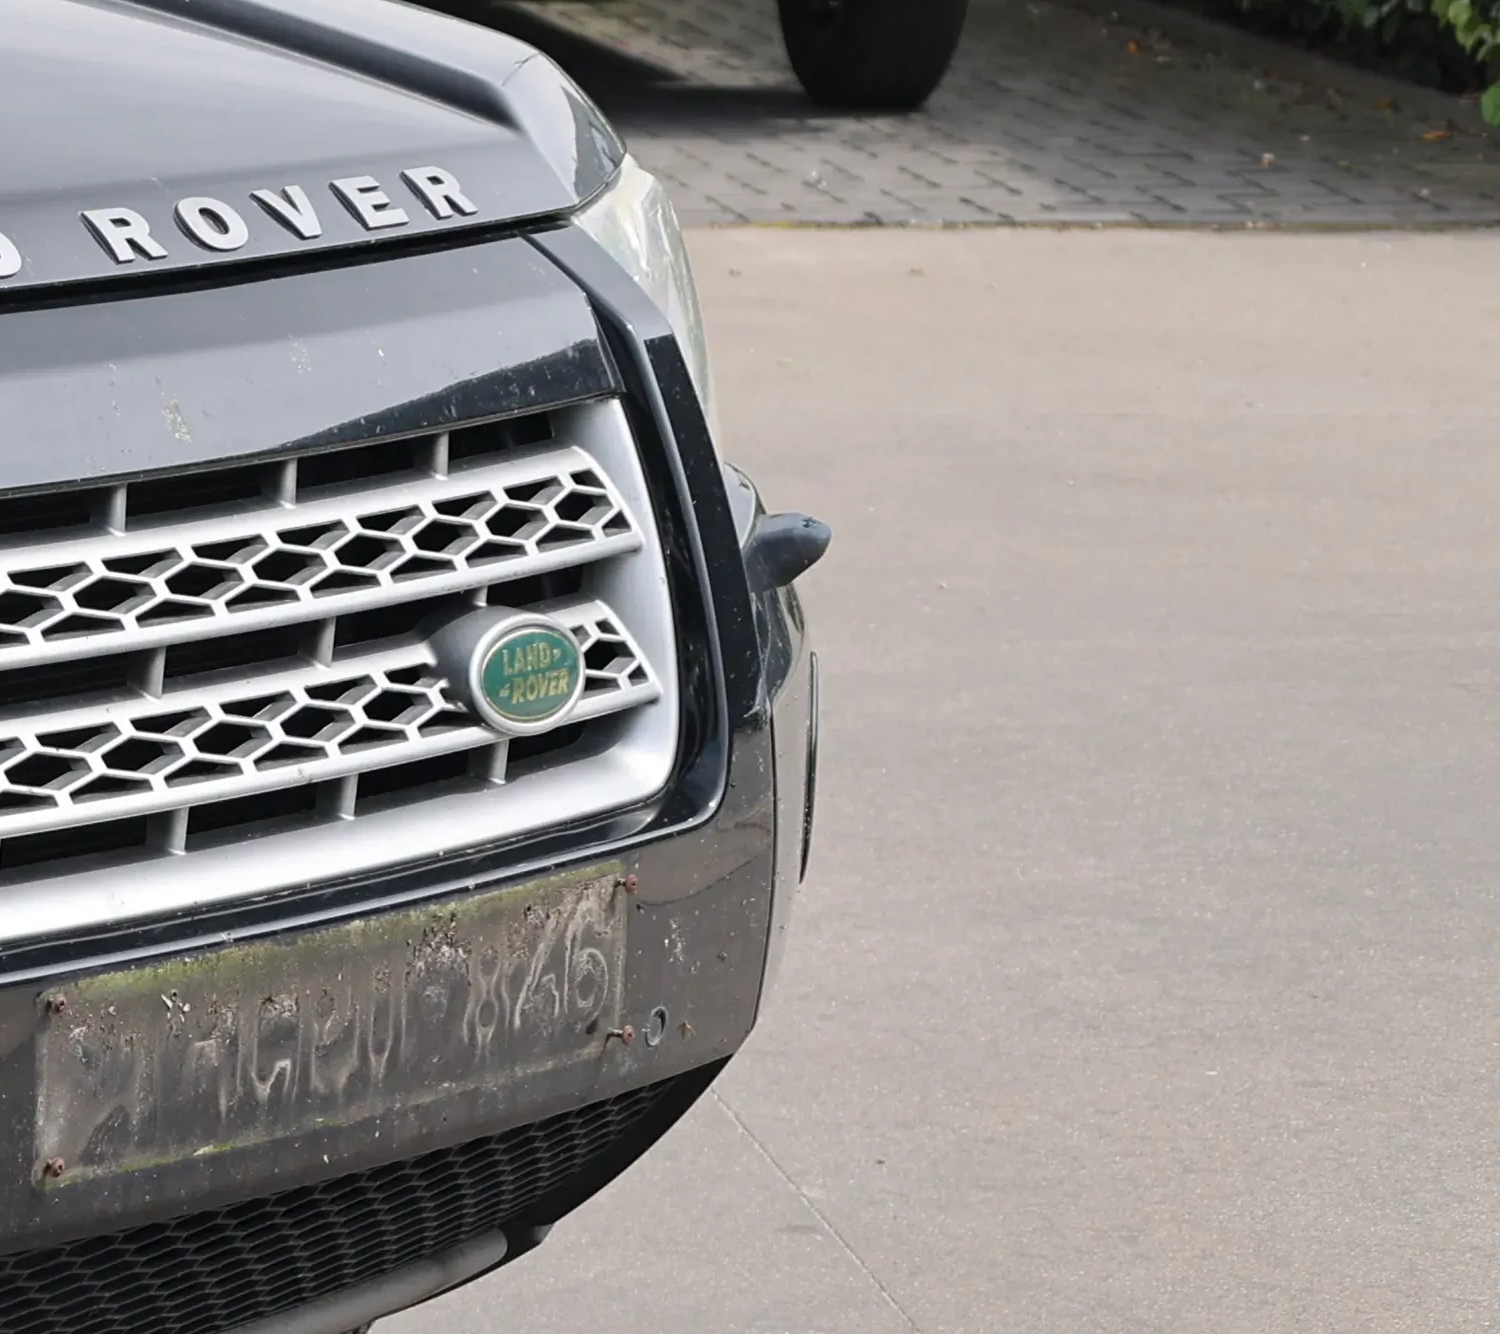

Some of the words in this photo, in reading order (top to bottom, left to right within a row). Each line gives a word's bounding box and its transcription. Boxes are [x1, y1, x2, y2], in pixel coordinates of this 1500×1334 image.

[80, 164, 479, 265] ROVER
[502, 641, 551, 676] LAND
[510, 668, 571, 705] ROVER
